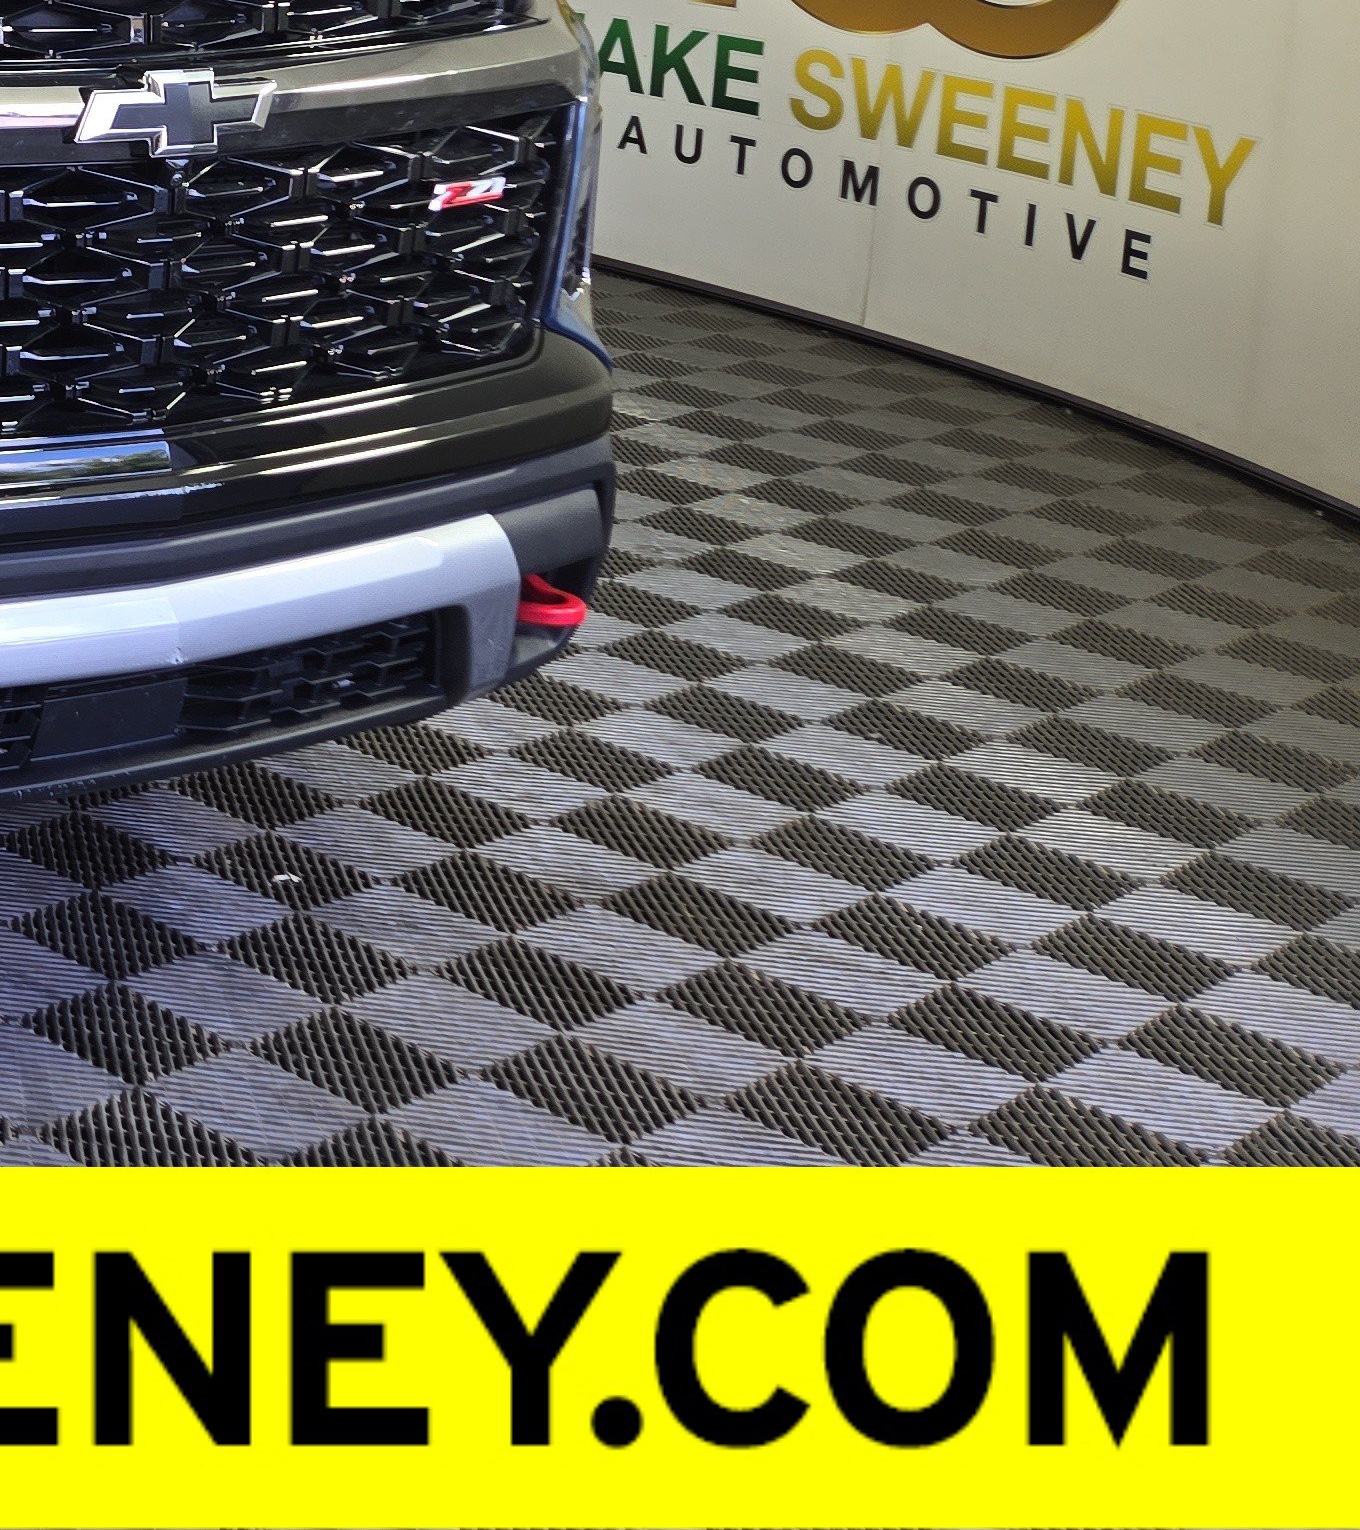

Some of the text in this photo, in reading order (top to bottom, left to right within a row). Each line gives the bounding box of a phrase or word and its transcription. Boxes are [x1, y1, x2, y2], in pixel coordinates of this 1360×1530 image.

[576, 13, 1256, 225] AKE SWEENEY
[618, 116, 1152, 279] AUTOMOTIVE
